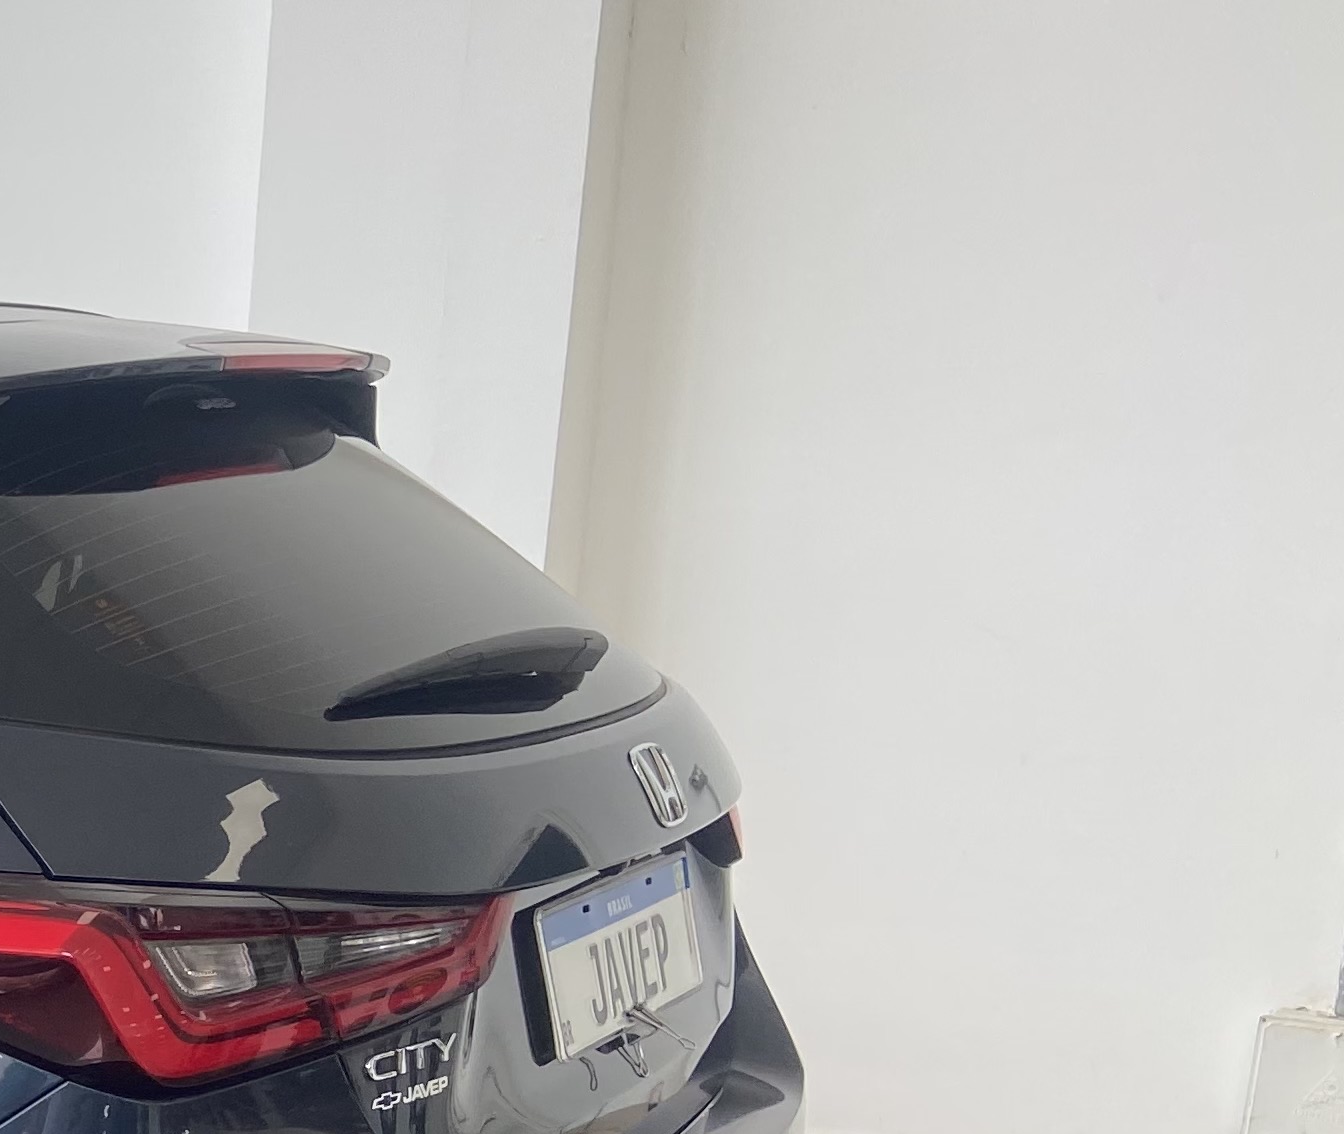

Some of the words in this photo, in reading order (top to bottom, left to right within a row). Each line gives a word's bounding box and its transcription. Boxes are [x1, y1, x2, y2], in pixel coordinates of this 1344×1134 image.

[607, 895, 633, 917] BRASIL
[587, 913, 669, 1027] JAVEP
[364, 1032, 457, 1081] CITY
[402, 1075, 449, 1104] JAVEP
